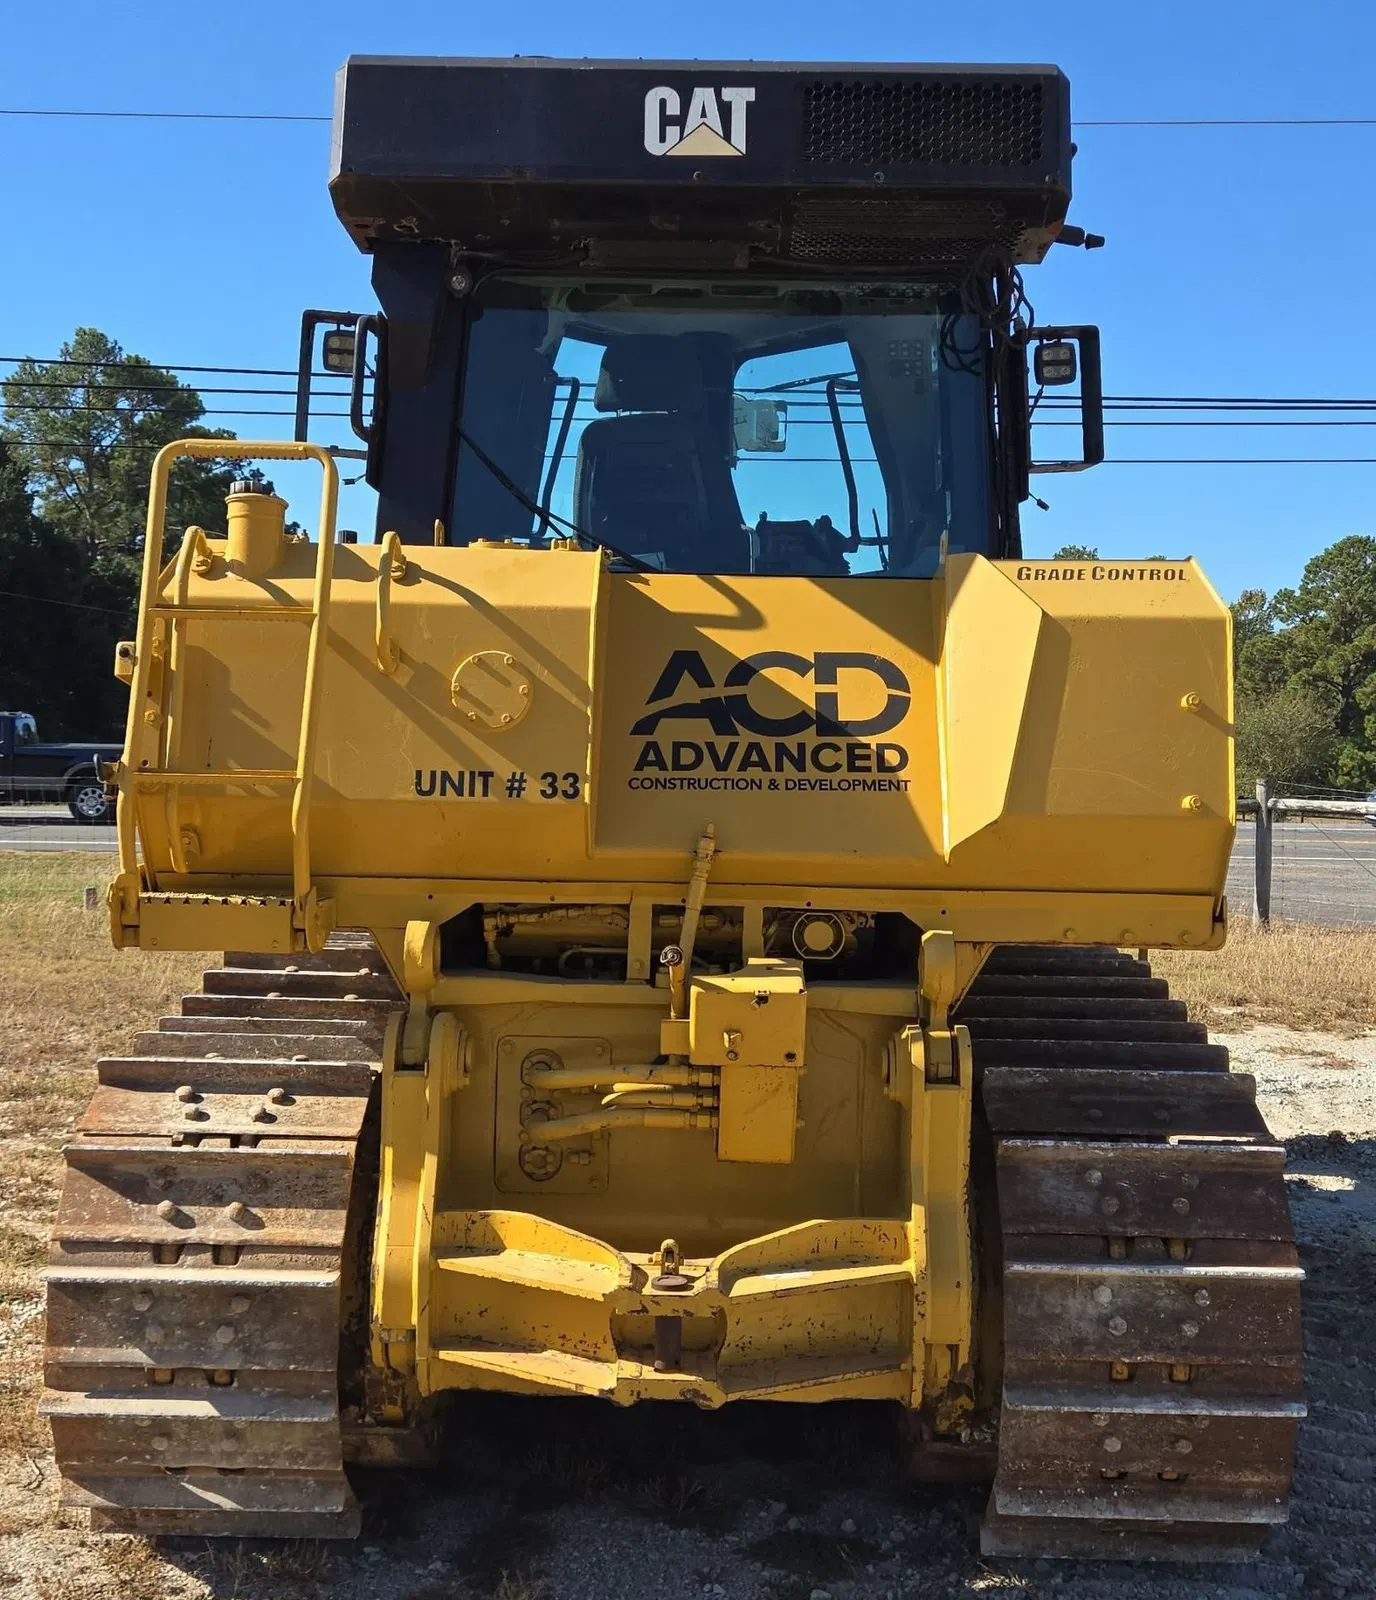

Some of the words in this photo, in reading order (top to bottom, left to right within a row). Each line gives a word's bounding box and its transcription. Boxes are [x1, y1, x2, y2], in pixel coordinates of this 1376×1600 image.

[644, 86, 755, 156] CAT
[1017, 566, 1087, 581] GRADE
[1092, 566, 1187, 581] CONTROL
[629, 650, 912, 738] ACD
[633, 741, 909, 773] ADVANCED
[415, 770, 494, 797] UNIT
[506, 772, 527, 798] #
[540, 772, 580, 800] 33
[628, 777, 763, 790] CONSTRUCTION
[768, 778, 780, 791] &
[785, 778, 911, 792] DEVELOPMENT
